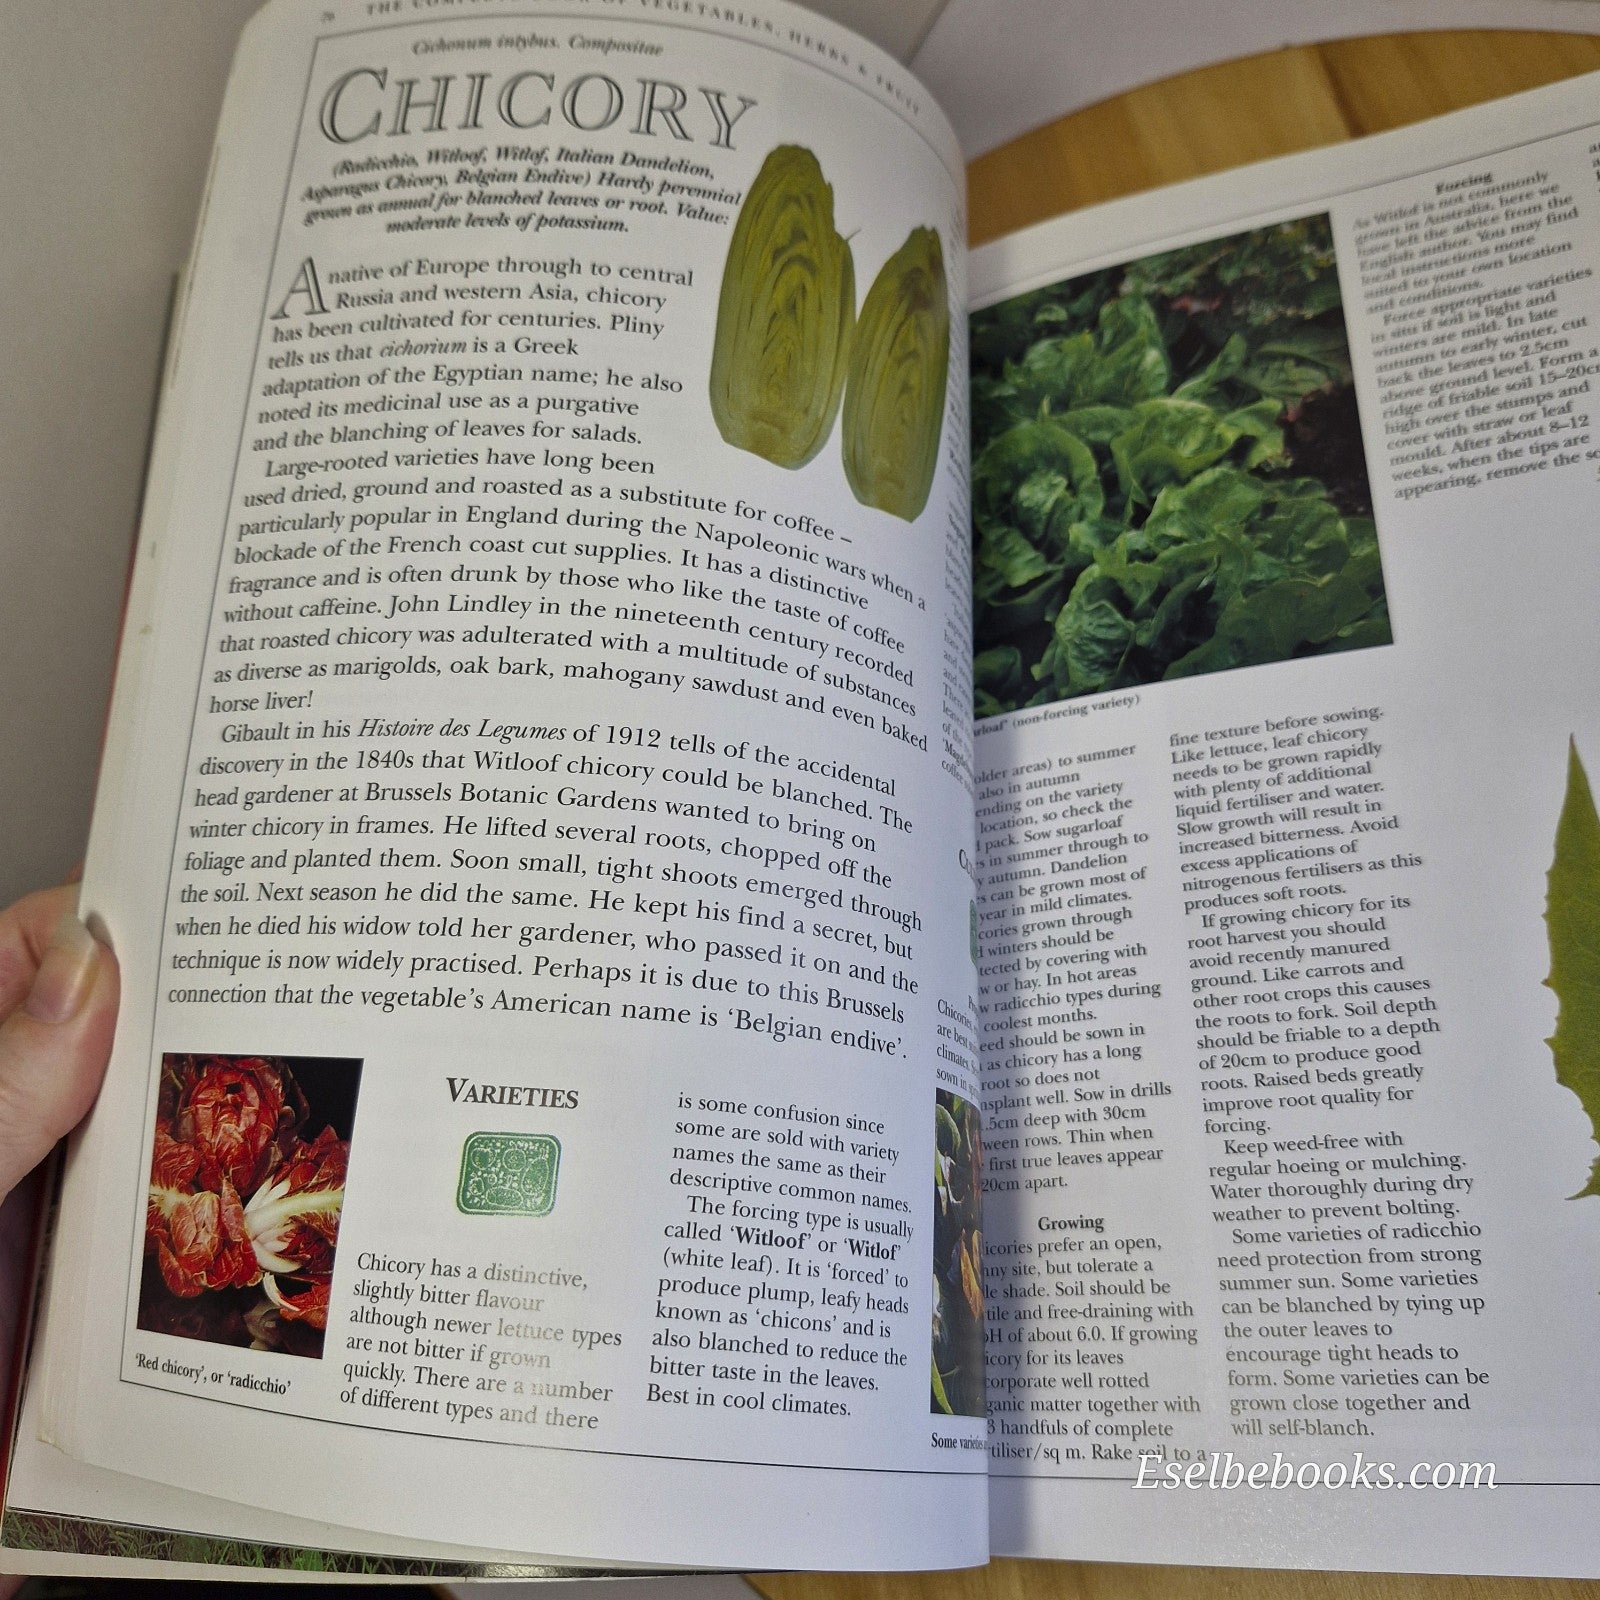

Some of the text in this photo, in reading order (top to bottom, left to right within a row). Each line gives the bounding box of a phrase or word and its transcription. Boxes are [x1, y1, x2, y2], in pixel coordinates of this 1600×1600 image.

[319, 67, 758, 150] CHICORY
[428, 146, 488, 166] Witloof,
[496, 146, 550, 165] Witlof,
[556, 146, 614, 164] Italian
[620, 151, 714, 180] Dandelion,
[455, 168, 518, 187] Belgian
[524, 168, 591, 186] Endive)
[597, 172, 654, 194] Hardy
[658, 180, 742, 205] perennial
[1435, 171, 1493, 195] Forcing
[356, 204, 374, 215] as
[432, 191, 461, 212] for
[466, 190, 544, 206] blanched
[548, 190, 600, 207] leaves
[605, 198, 625, 209] or
[629, 200, 668, 214] root.
[678, 202, 728, 224] Value:
[386, 212, 628, 233] moderate levels of potassium.
[328, 265, 384, 284] native
[389, 257, 412, 278] of
[415, 258, 490, 279] Europe
[498, 256, 581, 279] through
[590, 262, 611, 276] to
[618, 266, 693, 286] central
[336, 282, 666, 314] Russia and western Asia, chicory
[273, 310, 664, 342] has been cultivated for centuries. Pliny
[268, 336, 578, 370] tells us that cichorium is a Greek
[1378, 372, 1412, 387] back
[1418, 367, 1444, 378] the
[1448, 356, 1494, 372] leaves
[1499, 351, 1516, 361] to
[1392, 434, 1590, 481] weeks, when the tips are
[209, 690, 313, 713] horse liver!
[1013, 695, 1140, 726] (non-forcing variety)
[221, 718, 895, 796] Gibault in his Histoire des Legumes of 1912 tells of the accidental
[1172, 728, 1368, 764] Like lettuce, leaf chicory
[199, 750, 912, 833] discovery in the 1840s that Witloof chicory could be blanched. The
[980, 798, 1132, 834] location, so check the
[1193, 980, 1431, 1008] other root crops this causes
[678, 1092, 884, 1134] is some confusion since
[981, 1176, 1068, 1193] 20cm apart.
[1038, 1214, 1104, 1233] Growing
[1212, 1199, 1460, 1224] weather to prevent bolting.
[358, 1252, 587, 1290] Chicory has a distinctive,
[346, 1336, 551, 1371] are not bitter if grown
[211, 1372, 224, 1384] or
[650, 1355, 878, 1390] bitter taste in the leaves.
[1228, 1368, 1490, 1386] form. Some varieties can be
[646, 1383, 850, 1416] Best in cool climates.
[1231, 1418, 1374, 1436] will self-blanch.
